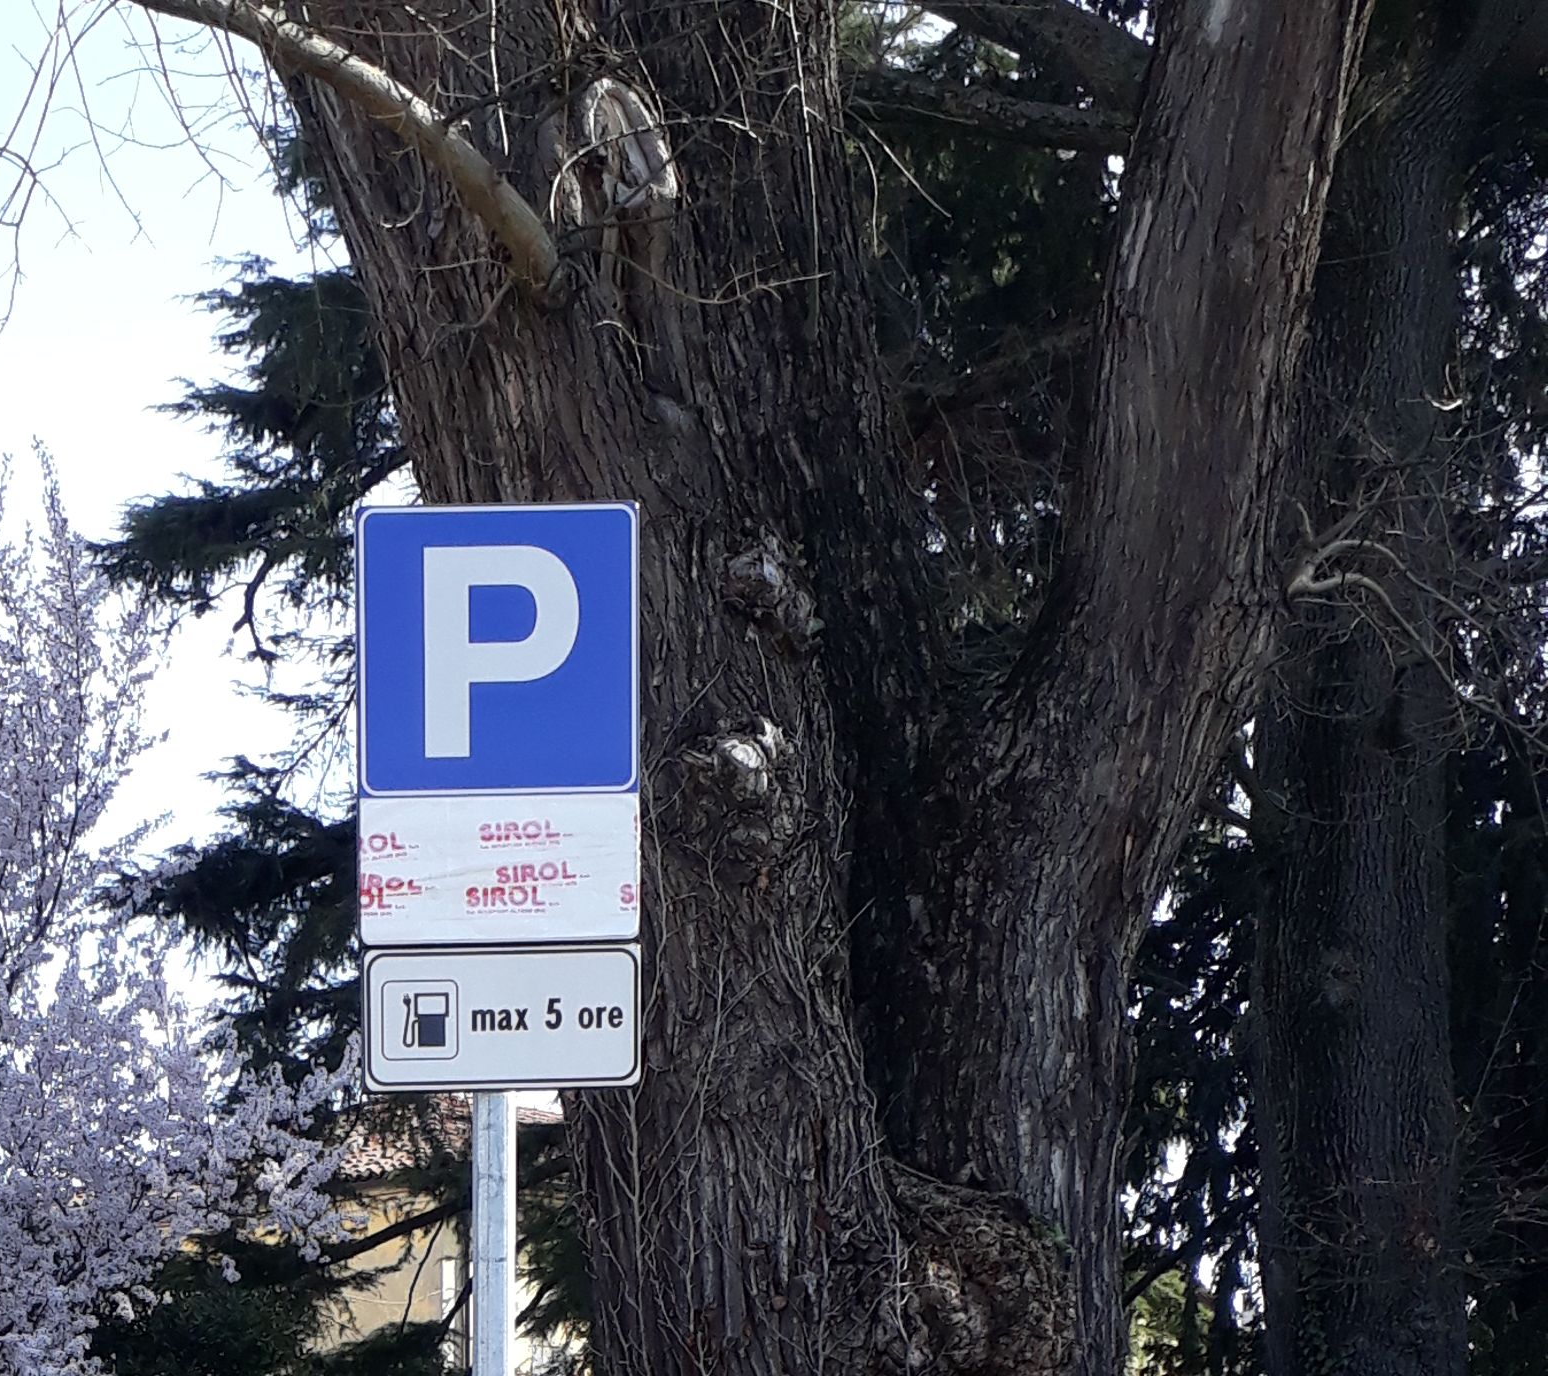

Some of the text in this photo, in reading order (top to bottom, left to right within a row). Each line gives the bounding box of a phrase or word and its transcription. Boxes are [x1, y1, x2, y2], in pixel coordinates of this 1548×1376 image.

[422, 544, 580, 759] P
[478, 820, 562, 842] SIROL
[496, 860, 577, 884] SIROL
[466, 885, 546, 908] SIROL
[471, 997, 624, 1032] max 5 ore
